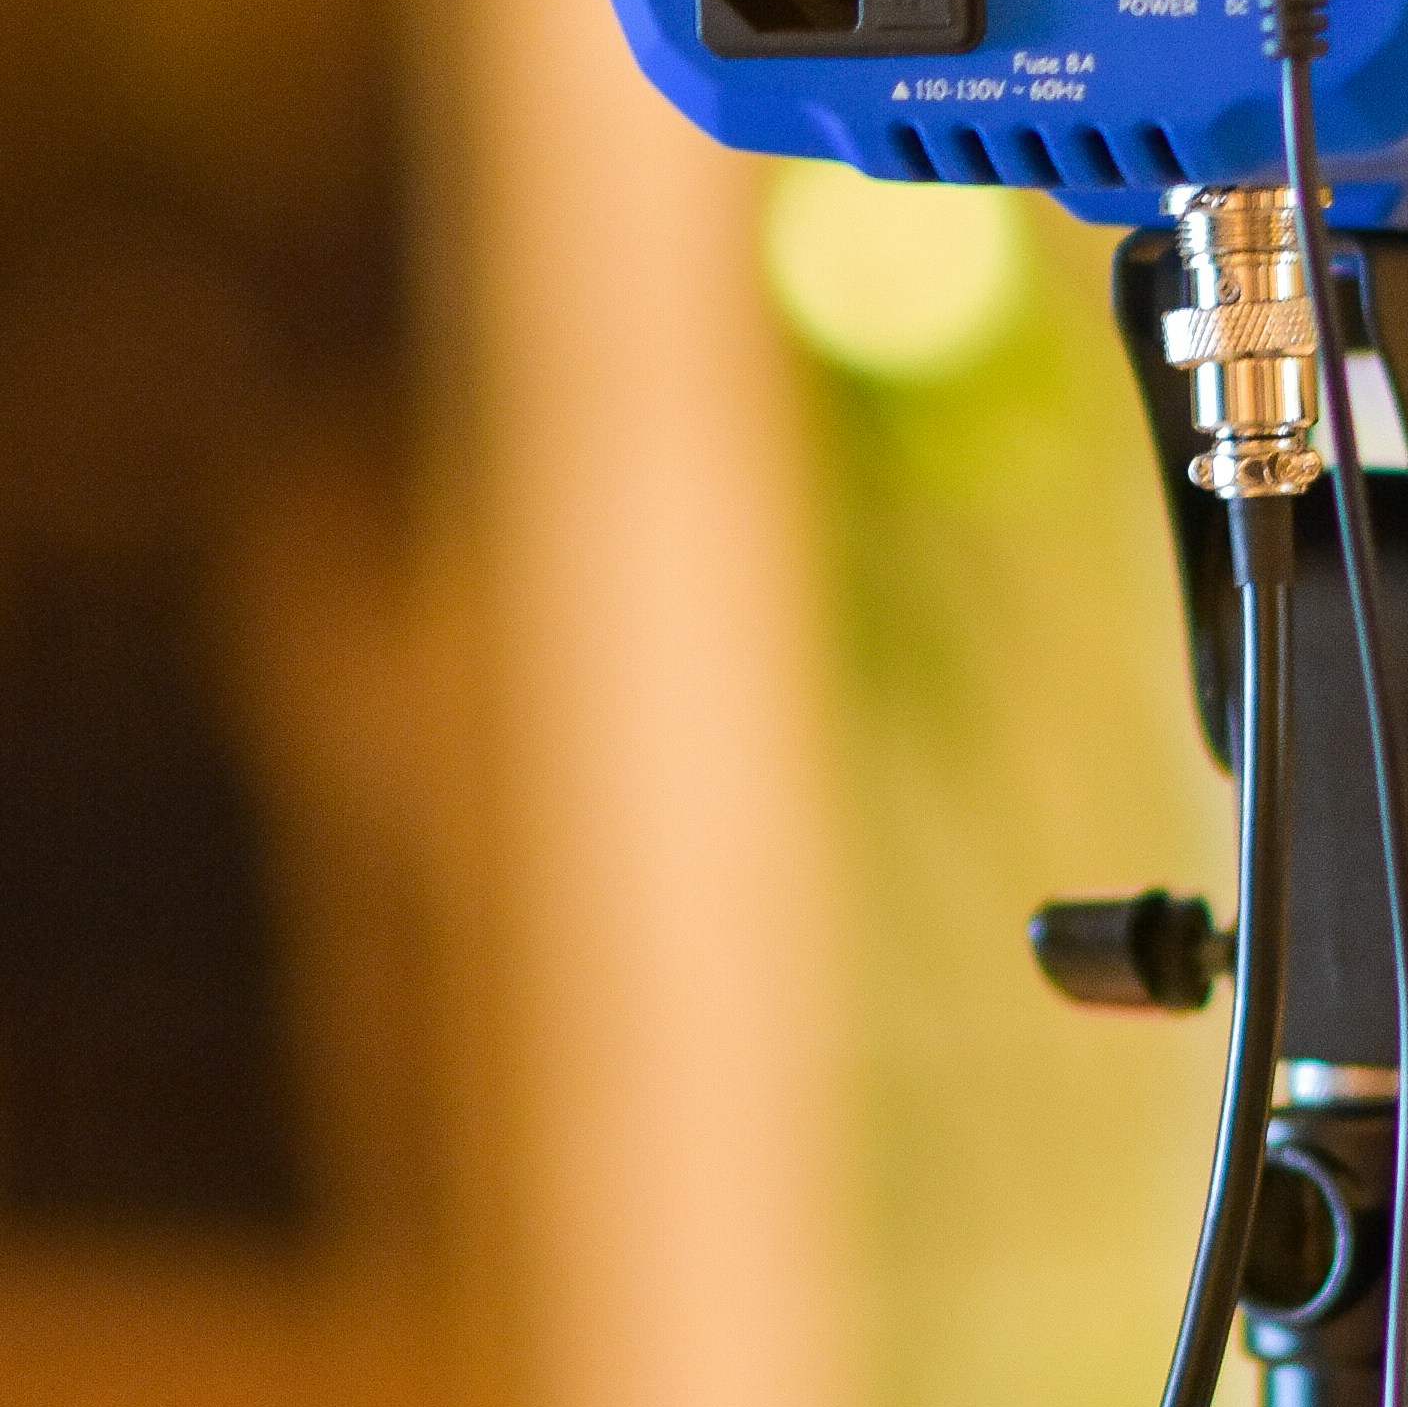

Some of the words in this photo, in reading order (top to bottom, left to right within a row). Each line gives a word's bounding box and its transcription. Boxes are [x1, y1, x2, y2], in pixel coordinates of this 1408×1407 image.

[1013, 50, 1060, 75] Fuse
[915, 77, 1007, 101] 110-130V
[1029, 78, 1086, 101] 60Hz
